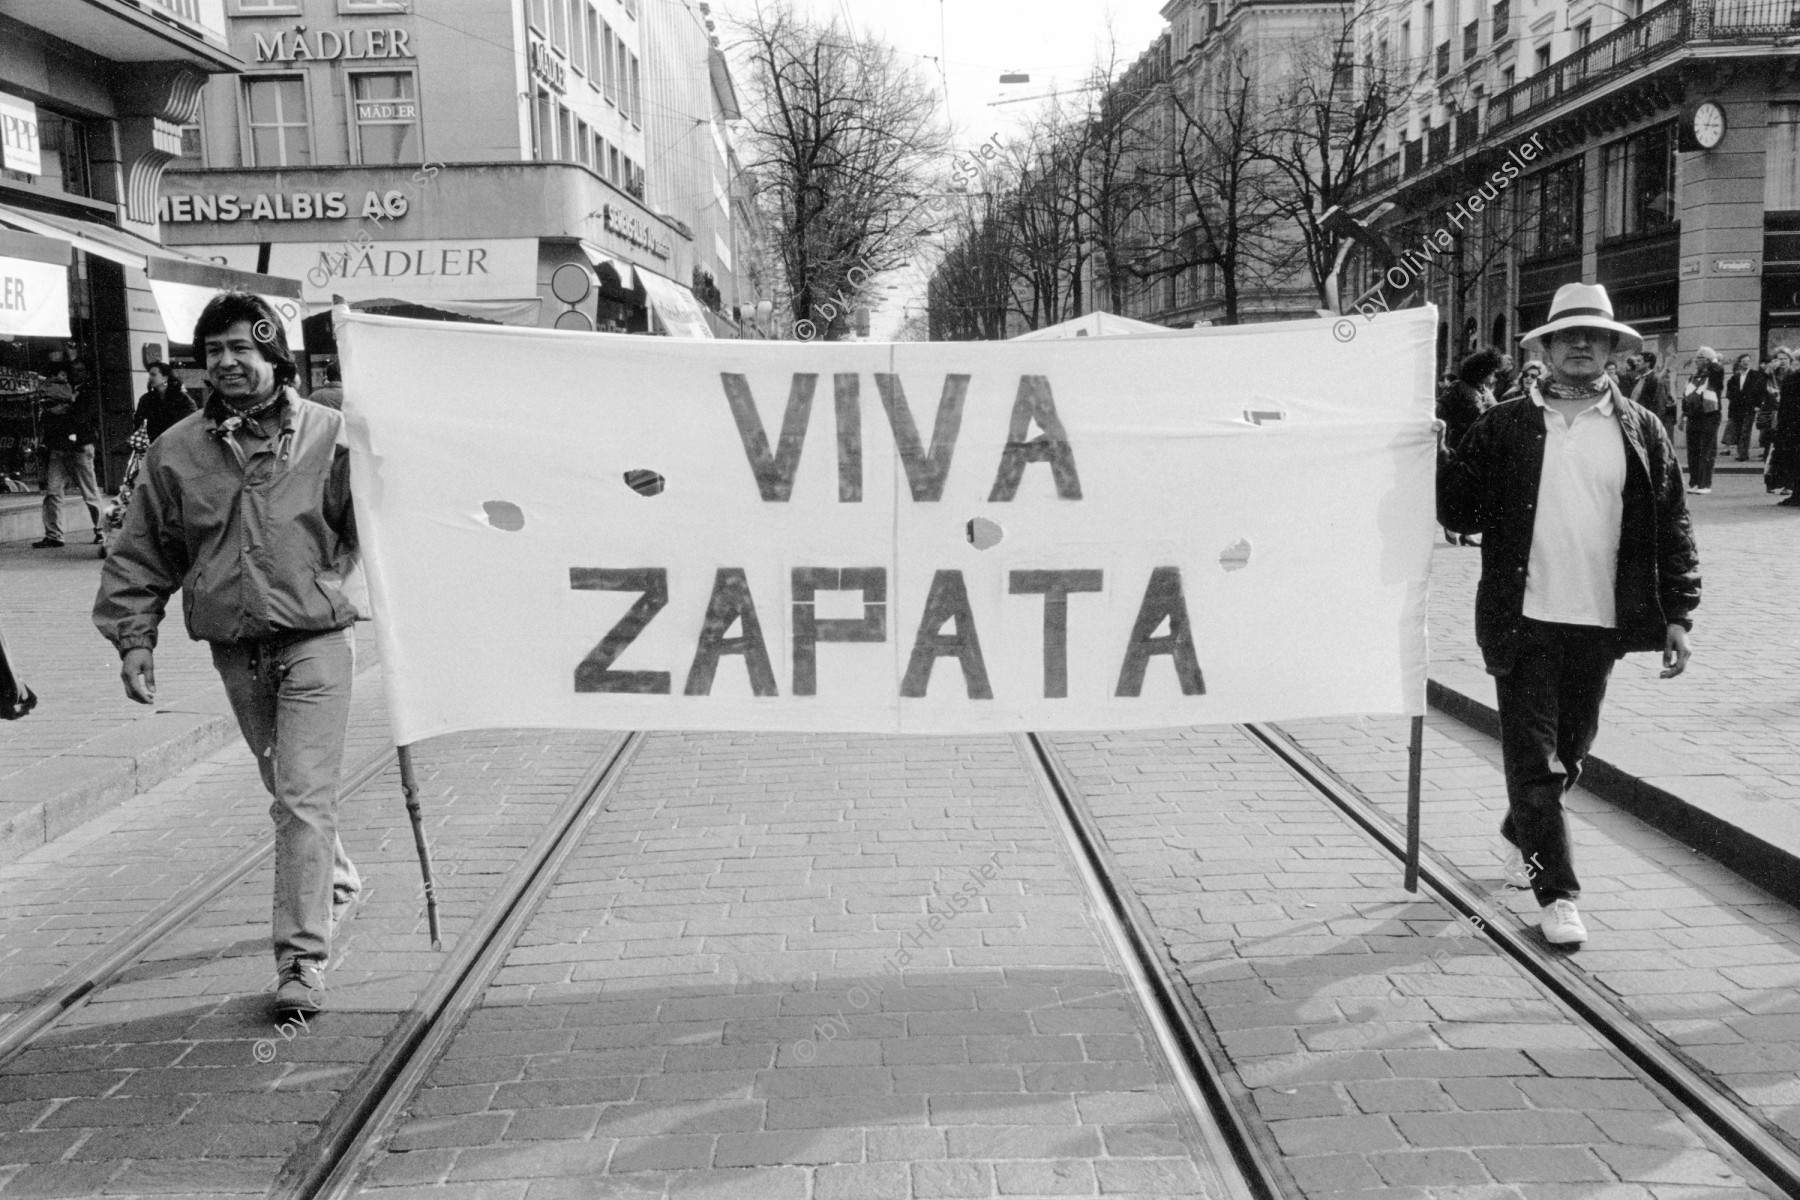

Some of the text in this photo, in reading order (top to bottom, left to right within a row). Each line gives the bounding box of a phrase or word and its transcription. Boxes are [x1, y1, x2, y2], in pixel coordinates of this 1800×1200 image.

[253, 25, 416, 62] MÄDLER
[359, 105, 417, 119] MÄDLER
[361, 190, 409, 218] AG
[316, 244, 489, 279] MÄDLER
[0, 276, 27, 311] ER
[720, 372, 1083, 503] VIVA
[569, 566, 1206, 700] ZAPATA
